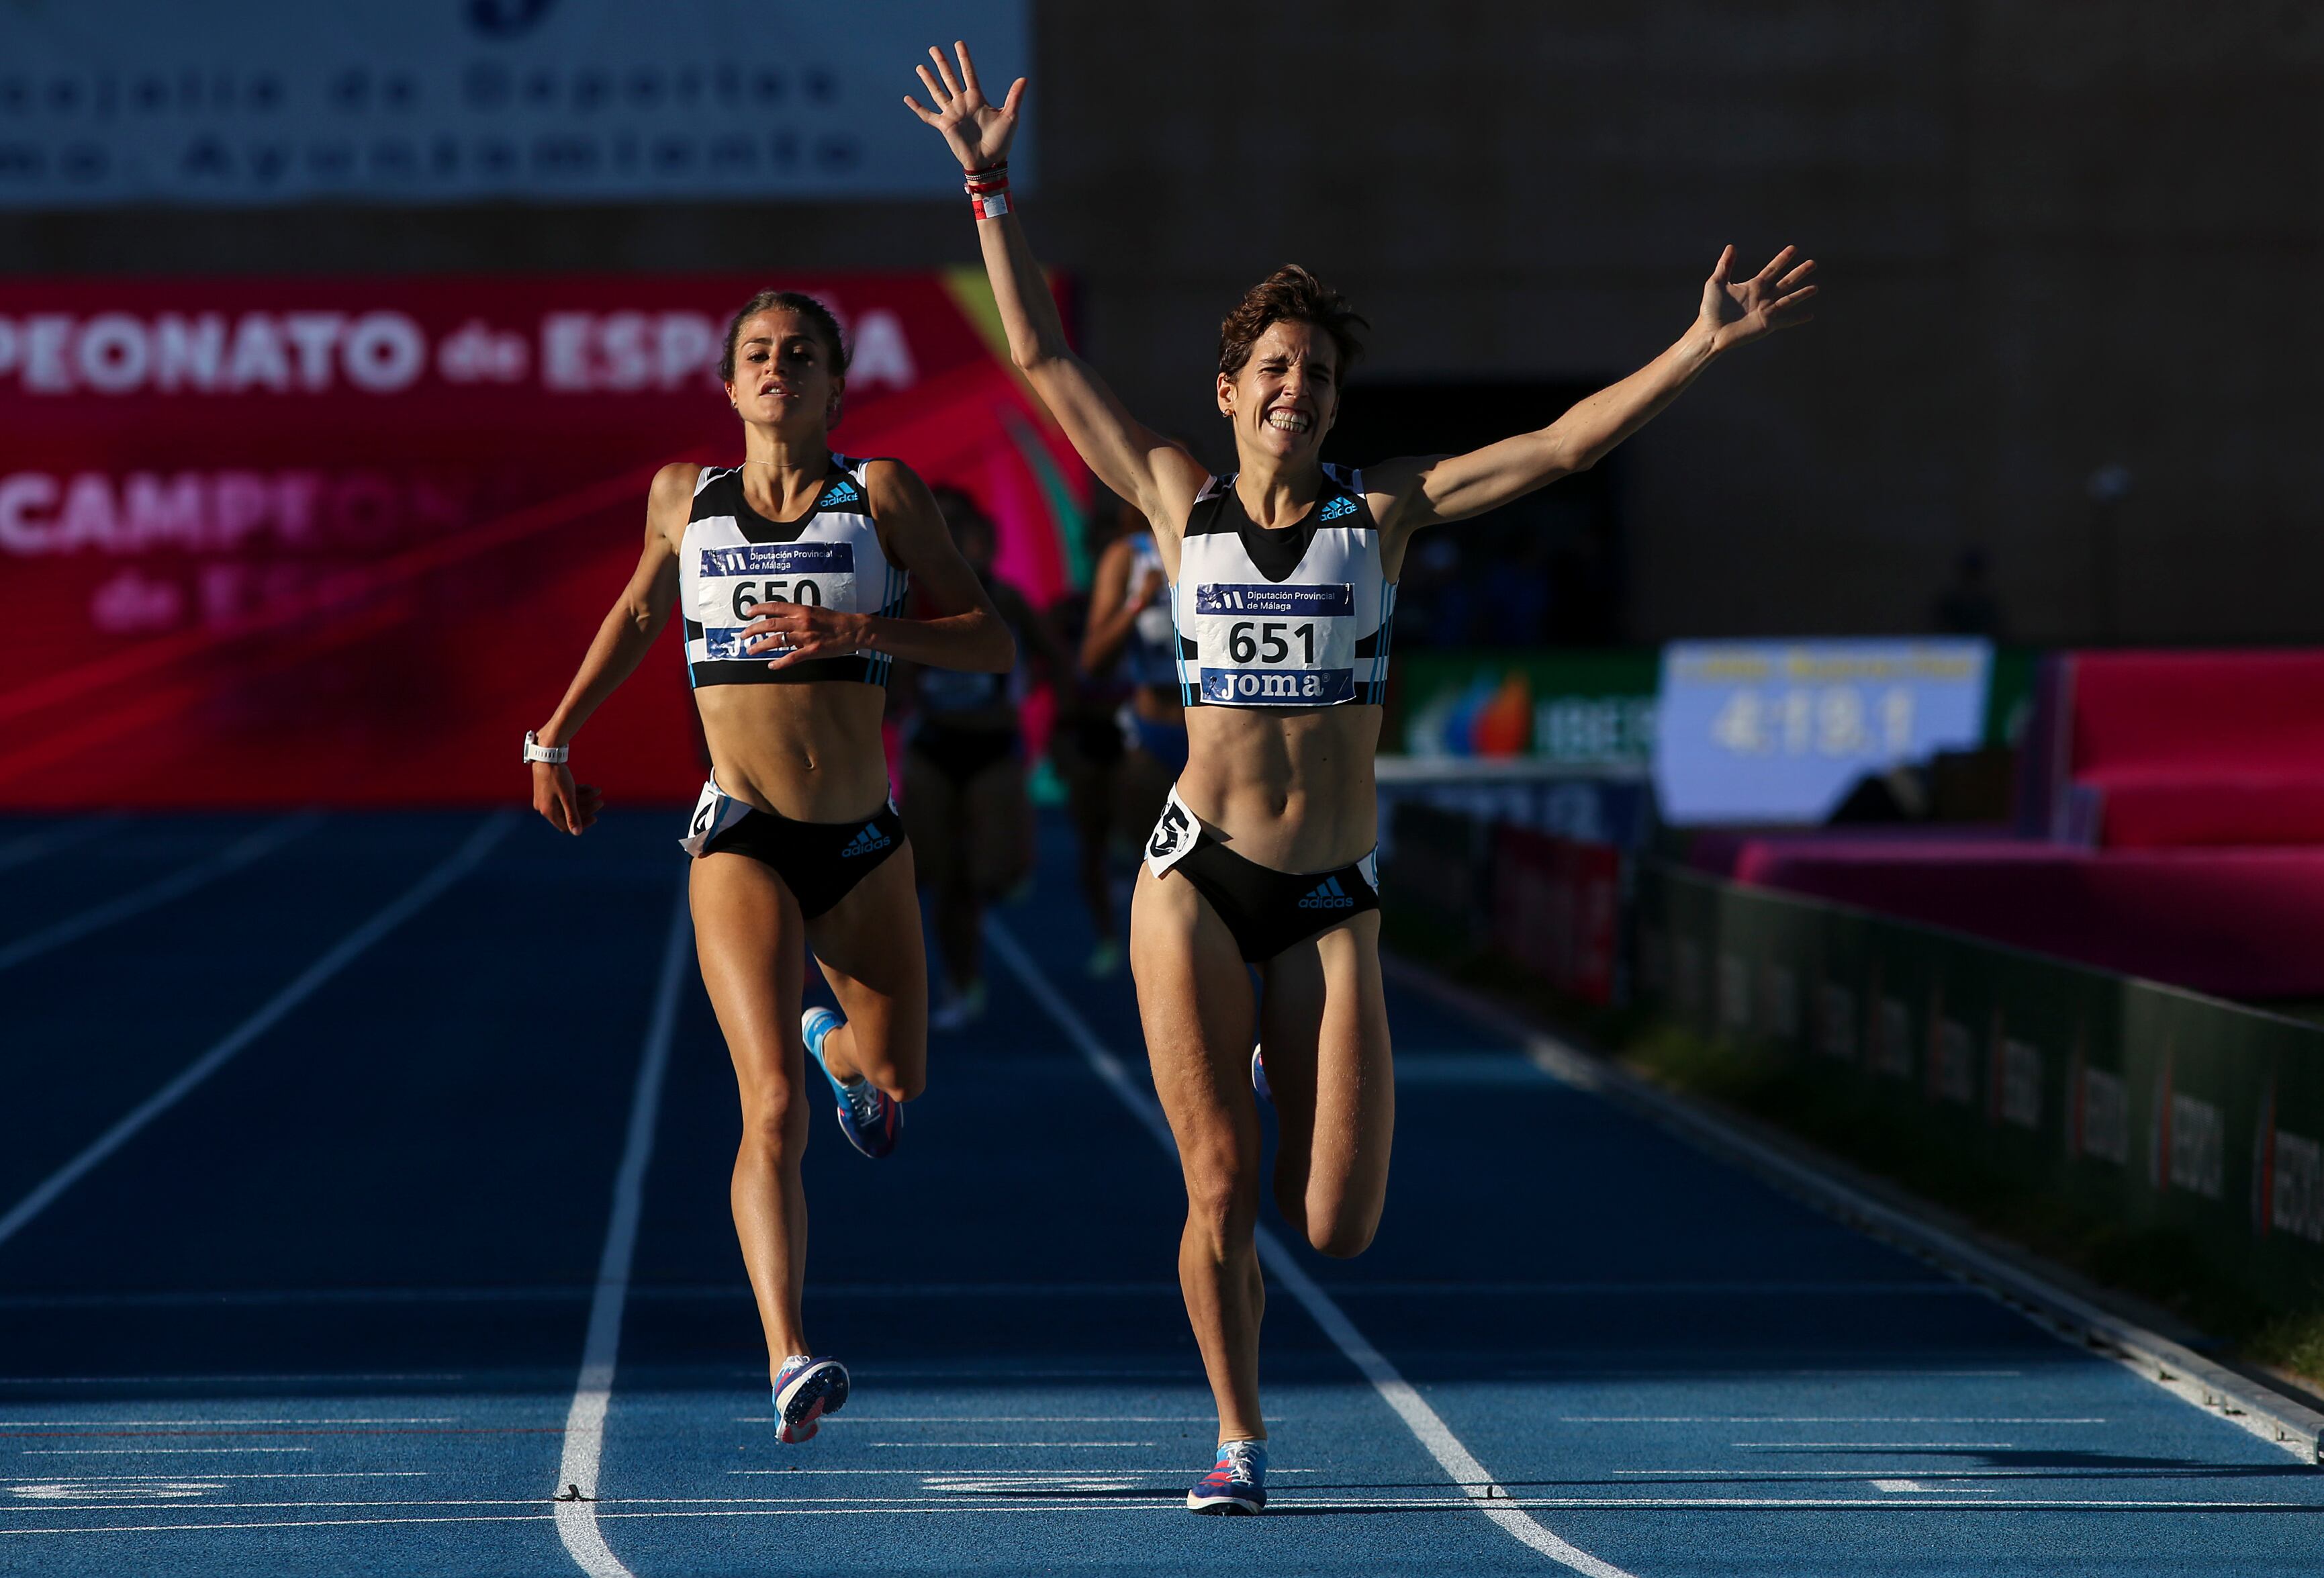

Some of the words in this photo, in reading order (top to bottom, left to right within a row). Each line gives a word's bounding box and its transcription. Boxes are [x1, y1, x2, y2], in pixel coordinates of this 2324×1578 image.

[543, 309, 917, 392] ESPA
[821, 492, 859, 508] adidas
[1319, 503, 1358, 522] adidas
[750, 550, 792, 561] Diputación
[794, 549, 833, 559] Provincial
[749, 562, 760, 570] de
[761, 561, 791, 571] Málaga
[732, 579, 821, 621] 650
[1247, 591, 1293, 601] Diputación
[1295, 592, 1335, 601] Provincial
[1247, 602, 1258, 610] de
[1260, 601, 1291, 612] Málaga
[1229, 621, 1314, 664] 651
[841, 835, 891, 858] adidas
[1298, 896, 1354, 909] adidas
